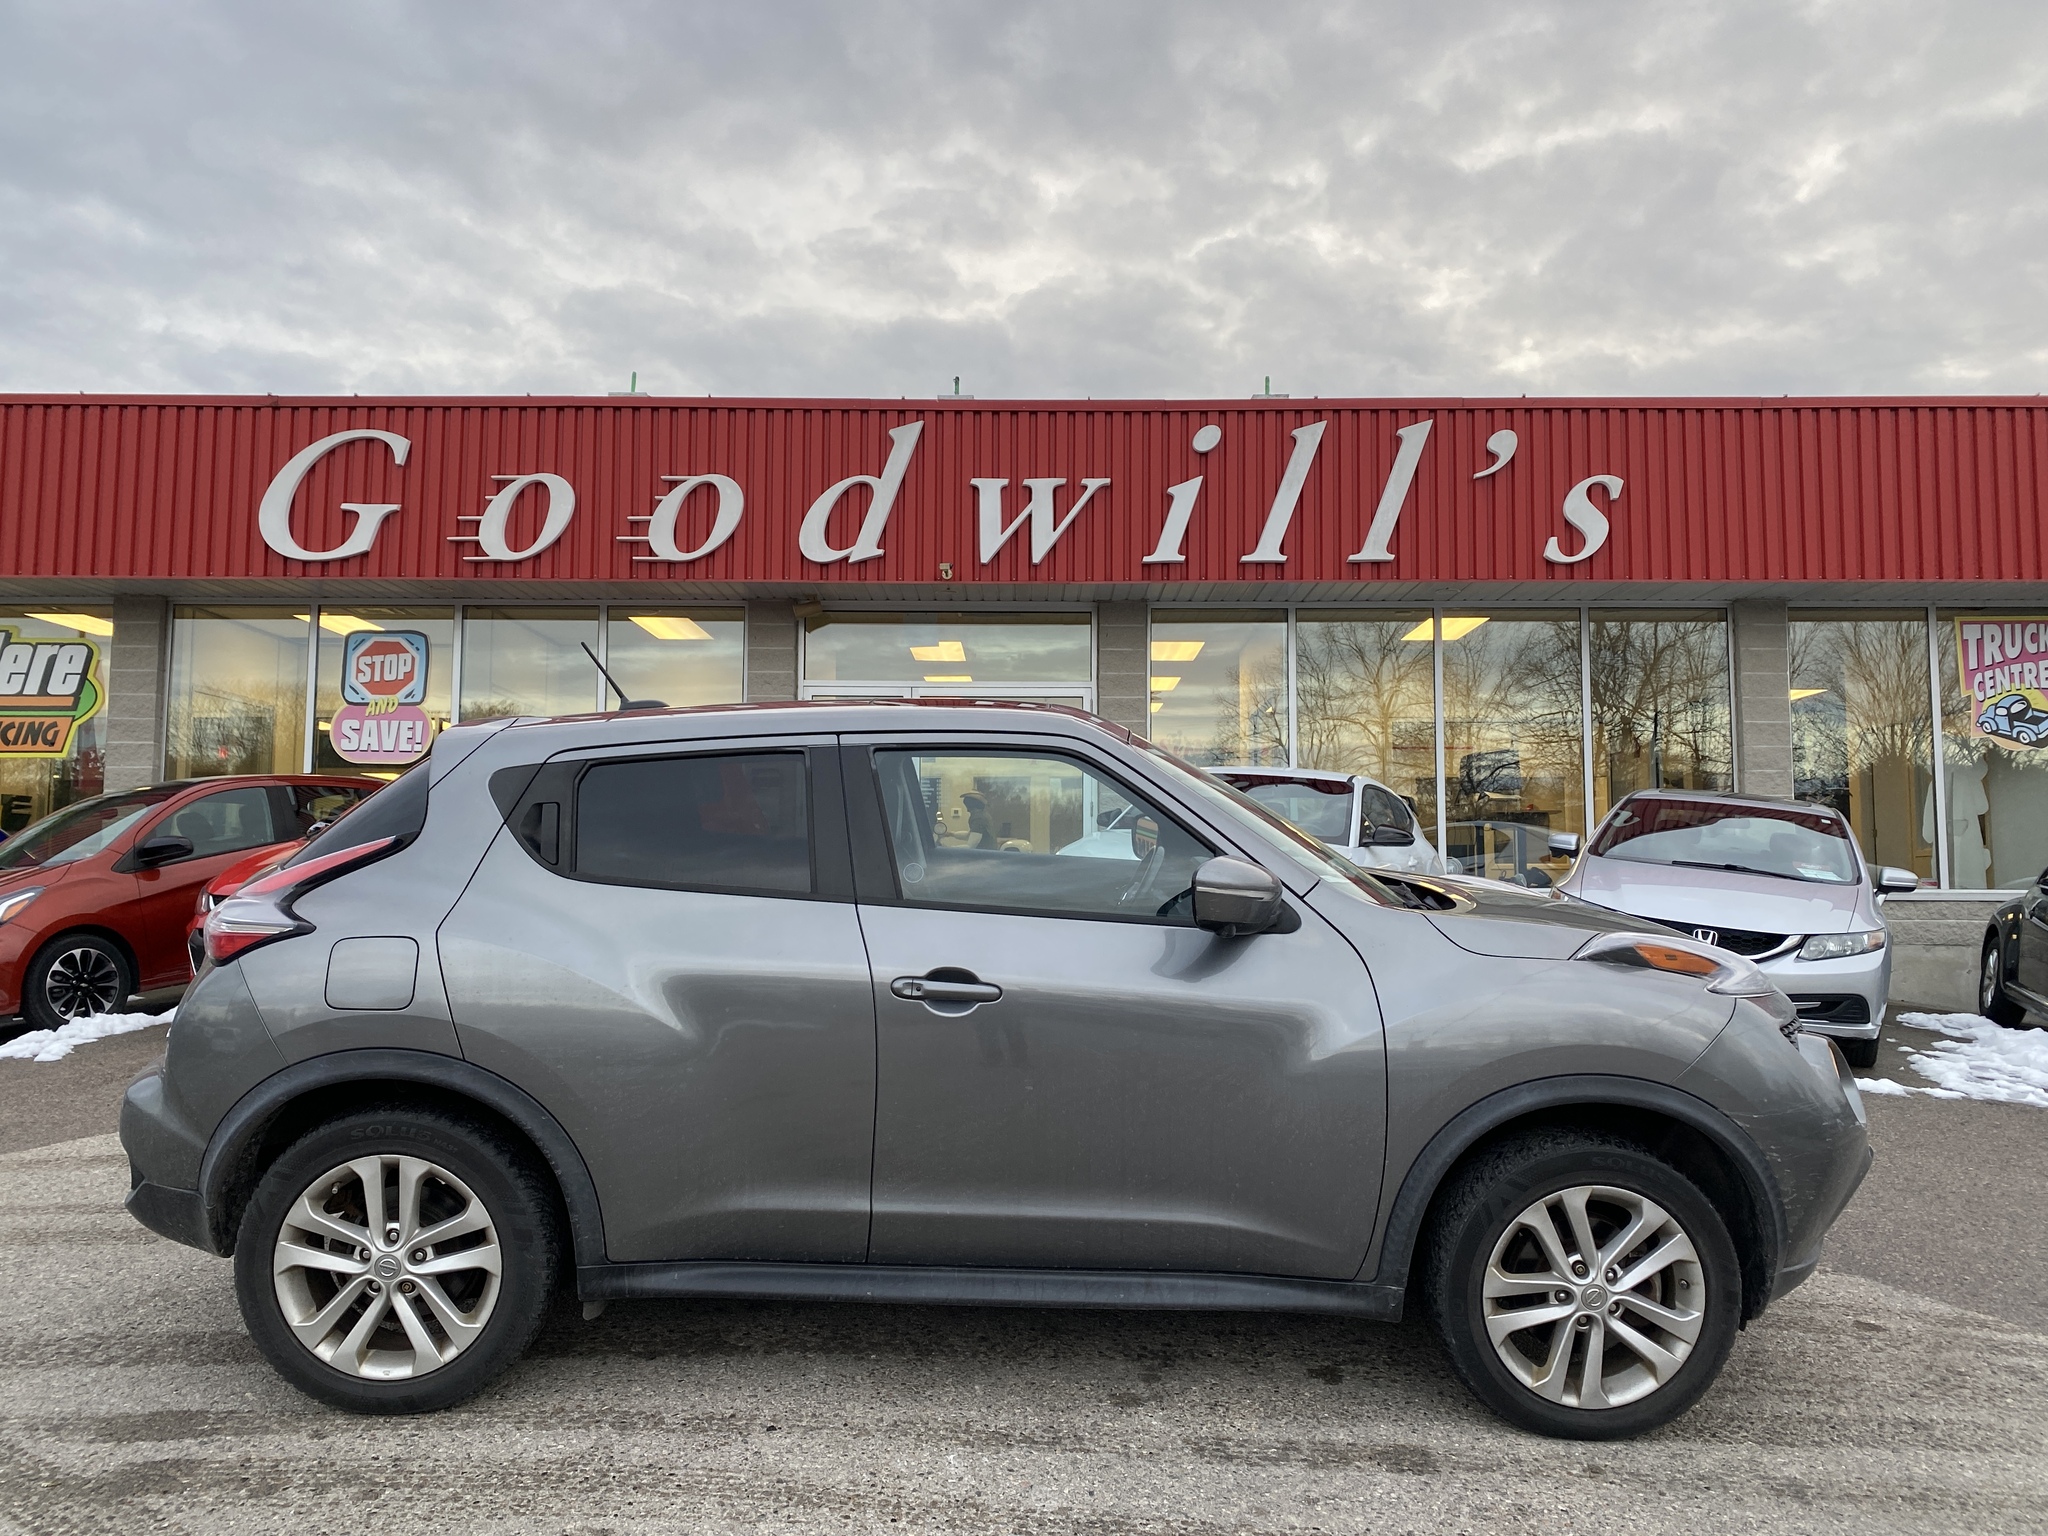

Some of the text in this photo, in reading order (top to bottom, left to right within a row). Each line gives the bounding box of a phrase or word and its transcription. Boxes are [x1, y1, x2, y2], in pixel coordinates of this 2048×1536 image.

[257, 420, 1625, 566] Goodwill's
[0, 632, 89, 695] ere
[357, 653, 413, 683] STOP
[1973, 659, 2048, 702] CENTRE
[365, 696, 399, 717] AND
[0, 721, 60, 747] CING
[340, 719, 424, 753] SAVE!
[350, 1125, 432, 1142] SOLUS
